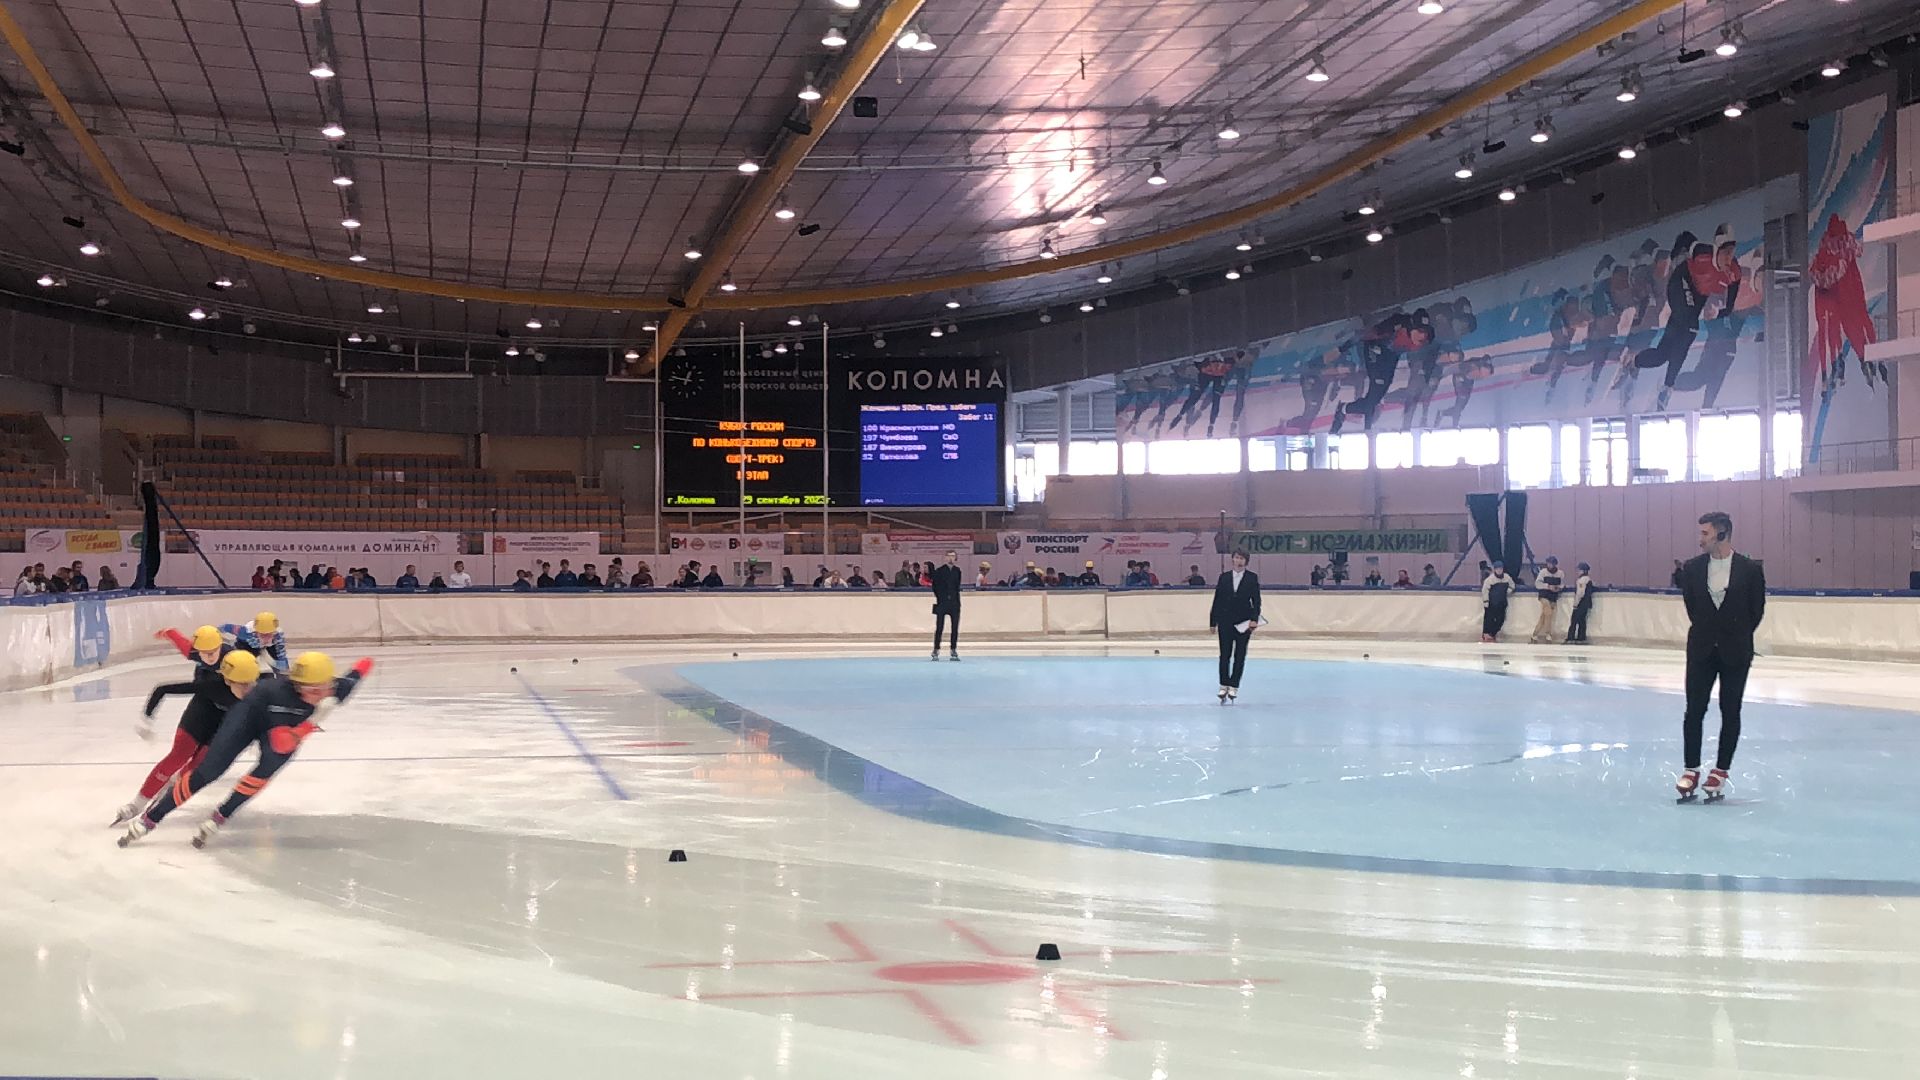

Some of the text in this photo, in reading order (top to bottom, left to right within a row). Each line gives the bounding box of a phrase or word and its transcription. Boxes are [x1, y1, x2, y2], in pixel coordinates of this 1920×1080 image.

[801, 370, 829, 378] ЦЕНТ
[848, 369, 1005, 391] КОЛОМНА
[692, 438, 706, 447] ПО
[782, 438, 816, 447] СПОРТУ
[745, 470, 769, 480] ЭТАП
[1026, 535, 1088, 543] МИНСПОРТ
[214, 543, 436, 553] УПРАВЛЯЮЩАЯ КОМПАНИЯ ДОМИНАНТ
